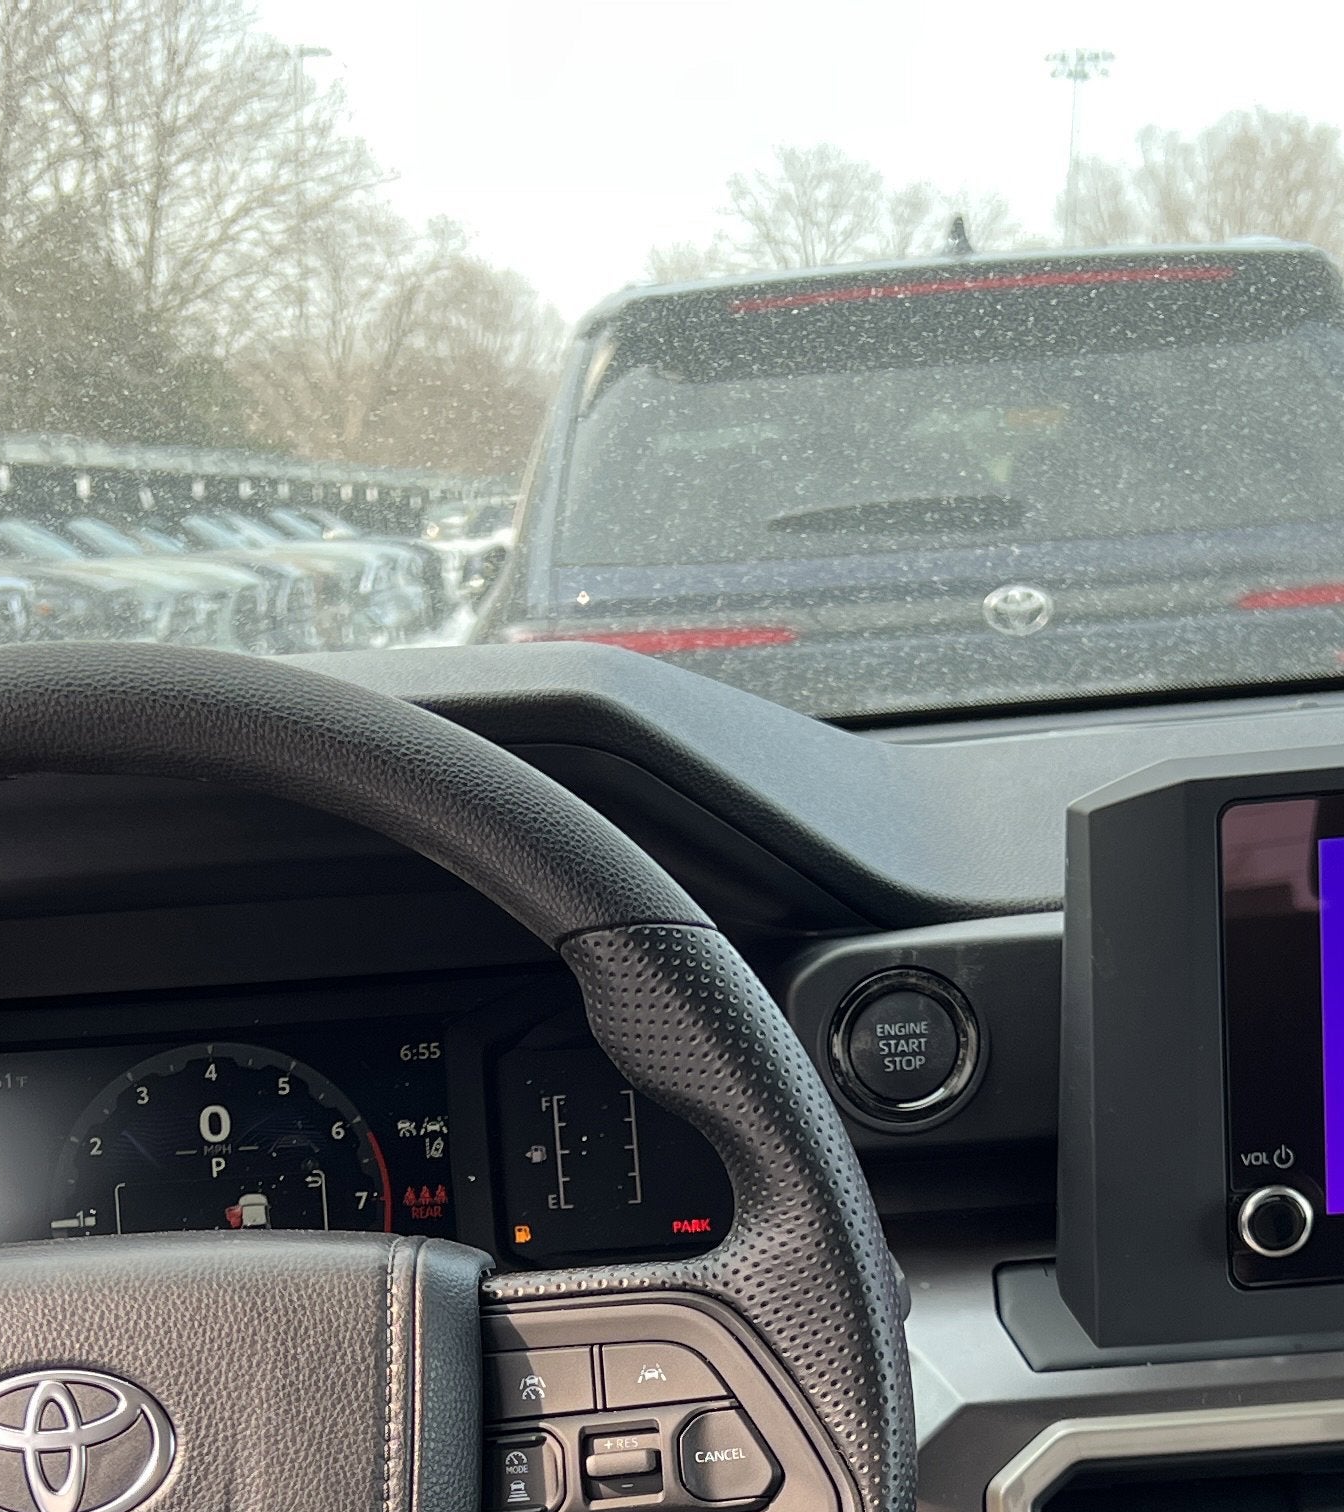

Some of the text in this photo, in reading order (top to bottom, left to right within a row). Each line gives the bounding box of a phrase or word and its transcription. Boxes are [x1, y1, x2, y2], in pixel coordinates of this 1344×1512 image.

[876, 1021, 929, 1037] ENGINE
[400, 1042, 441, 1061] 6:55
[878, 1038, 927, 1055] START
[884, 1055, 926, 1072] STOP
[204, 1064, 218, 1081] 4
[277, 1077, 290, 1095] 5
[137, 1086, 150, 1105] 3
[199, 1105, 231, 1142] 0
[331, 1122, 345, 1140] 6
[89, 1138, 103, 1156] 2
[203, 1143, 232, 1157] MPH
[212, 1157, 226, 1178] P
[1240, 1151, 1269, 1168] VOL
[356, 1192, 368, 1209] 7
[548, 1194, 558, 1209] E
[411, 1205, 443, 1219] REAR
[672, 1218, 711, 1234] PARK
[694, 1448, 746, 1464] CANCEL
[505, 1464, 529, 1475] MODE
